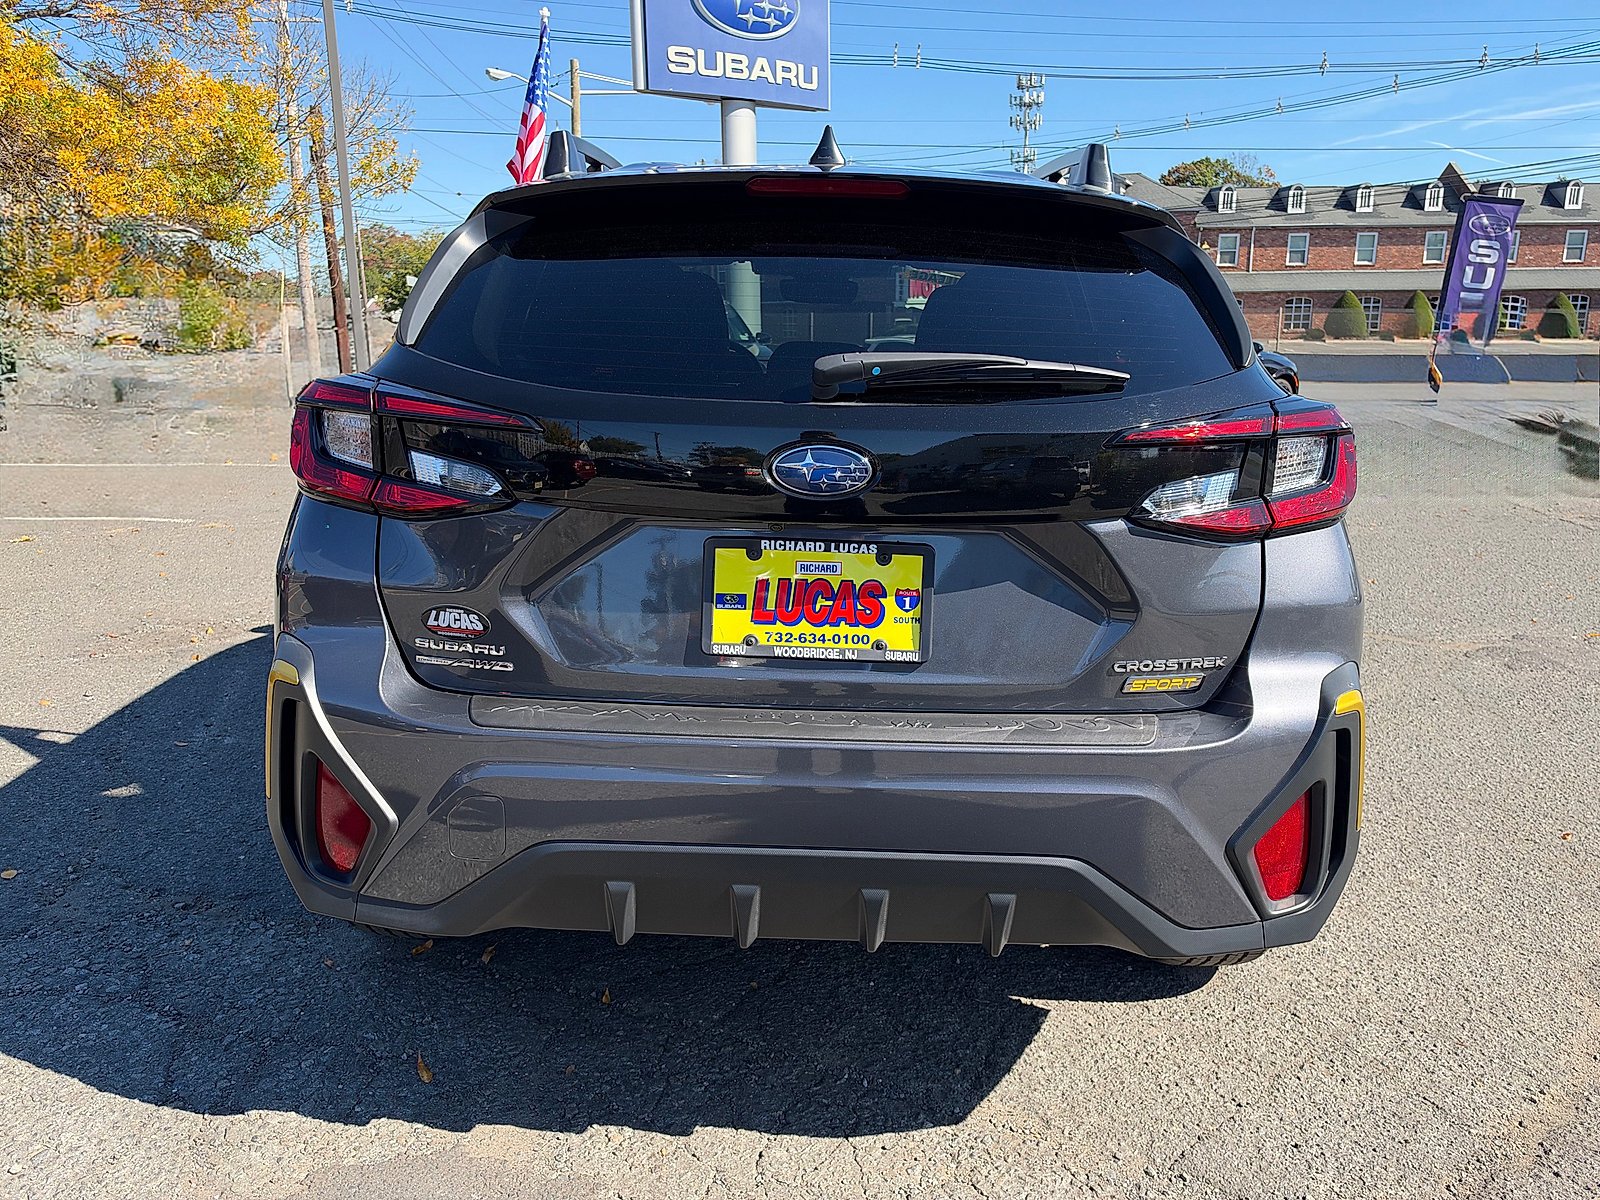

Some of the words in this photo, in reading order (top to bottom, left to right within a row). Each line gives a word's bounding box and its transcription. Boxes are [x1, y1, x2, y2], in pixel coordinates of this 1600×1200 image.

[667, 45, 819, 91] SUBARU
[761, 540, 825, 552] RICHARD
[831, 542, 878, 554] LUCAS
[799, 563, 838, 573] RICHARD
[751, 577, 888, 629] LUCAS
[902, 597, 912, 610] 1
[427, 610, 484, 631] LUCAS
[894, 616, 920, 624] SOUTH
[765, 631, 870, 645] 732-634-0100
[414, 637, 506, 656] SUBARU
[712, 645, 747, 655] SUBARU
[845, 649, 858, 660] NJ
[885, 651, 919, 661] SUBARU
[451, 658, 515, 671] AWD
[1113, 656, 1228, 672] CROSSTREK
[1129, 677, 1198, 691] SPORT
